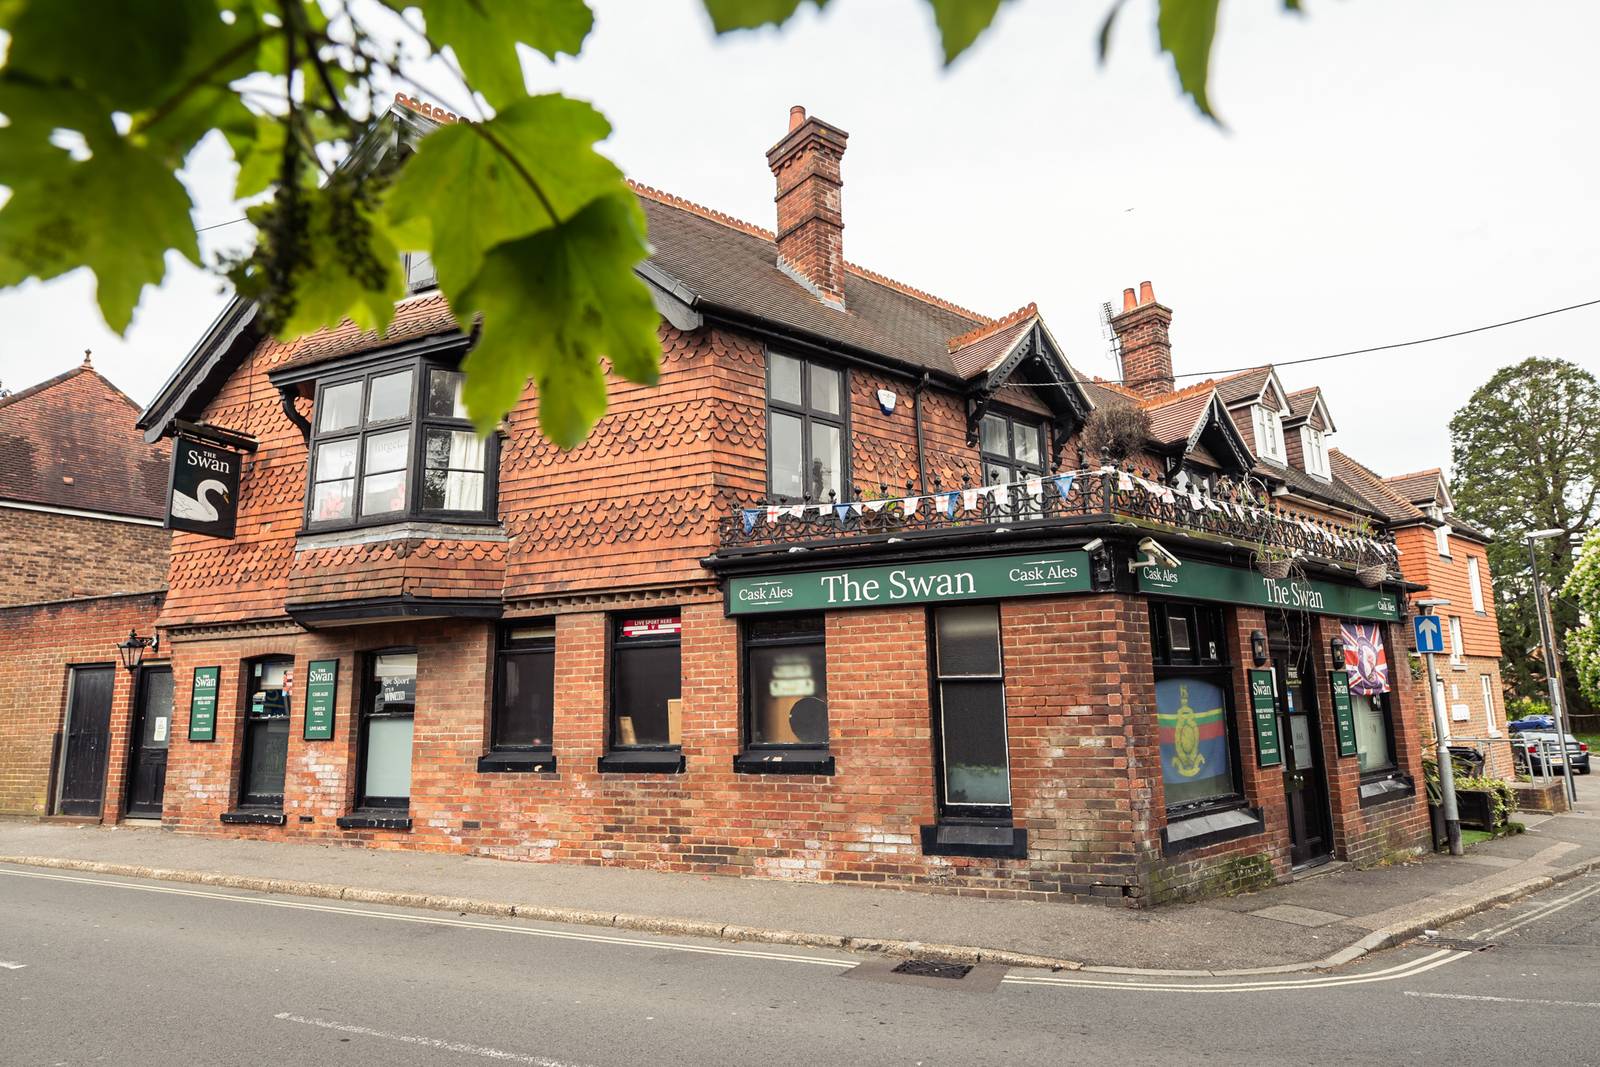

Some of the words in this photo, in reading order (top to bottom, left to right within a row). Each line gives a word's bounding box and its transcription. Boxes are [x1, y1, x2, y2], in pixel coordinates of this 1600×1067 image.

[187, 449, 230, 474] Swan
[203, 451, 217, 459] THE
[1009, 566, 1044, 582] Cask
[1047, 565, 1078, 579] Ales
[1143, 566, 1162, 581] Cask
[1163, 569, 1178, 583] Ales
[739, 588, 766, 601] Cask
[769, 586, 793, 599] Ales
[821, 573, 880, 603] The
[889, 569, 977, 600] Swan
[1263, 578, 1290, 605] The
[1291, 582, 1323, 609] Swan
[195, 676, 216, 688] Swan
[309, 670, 333, 682] Swan
[1252, 682, 1271, 696] Swan
[1333, 682, 1348, 694] Swan
